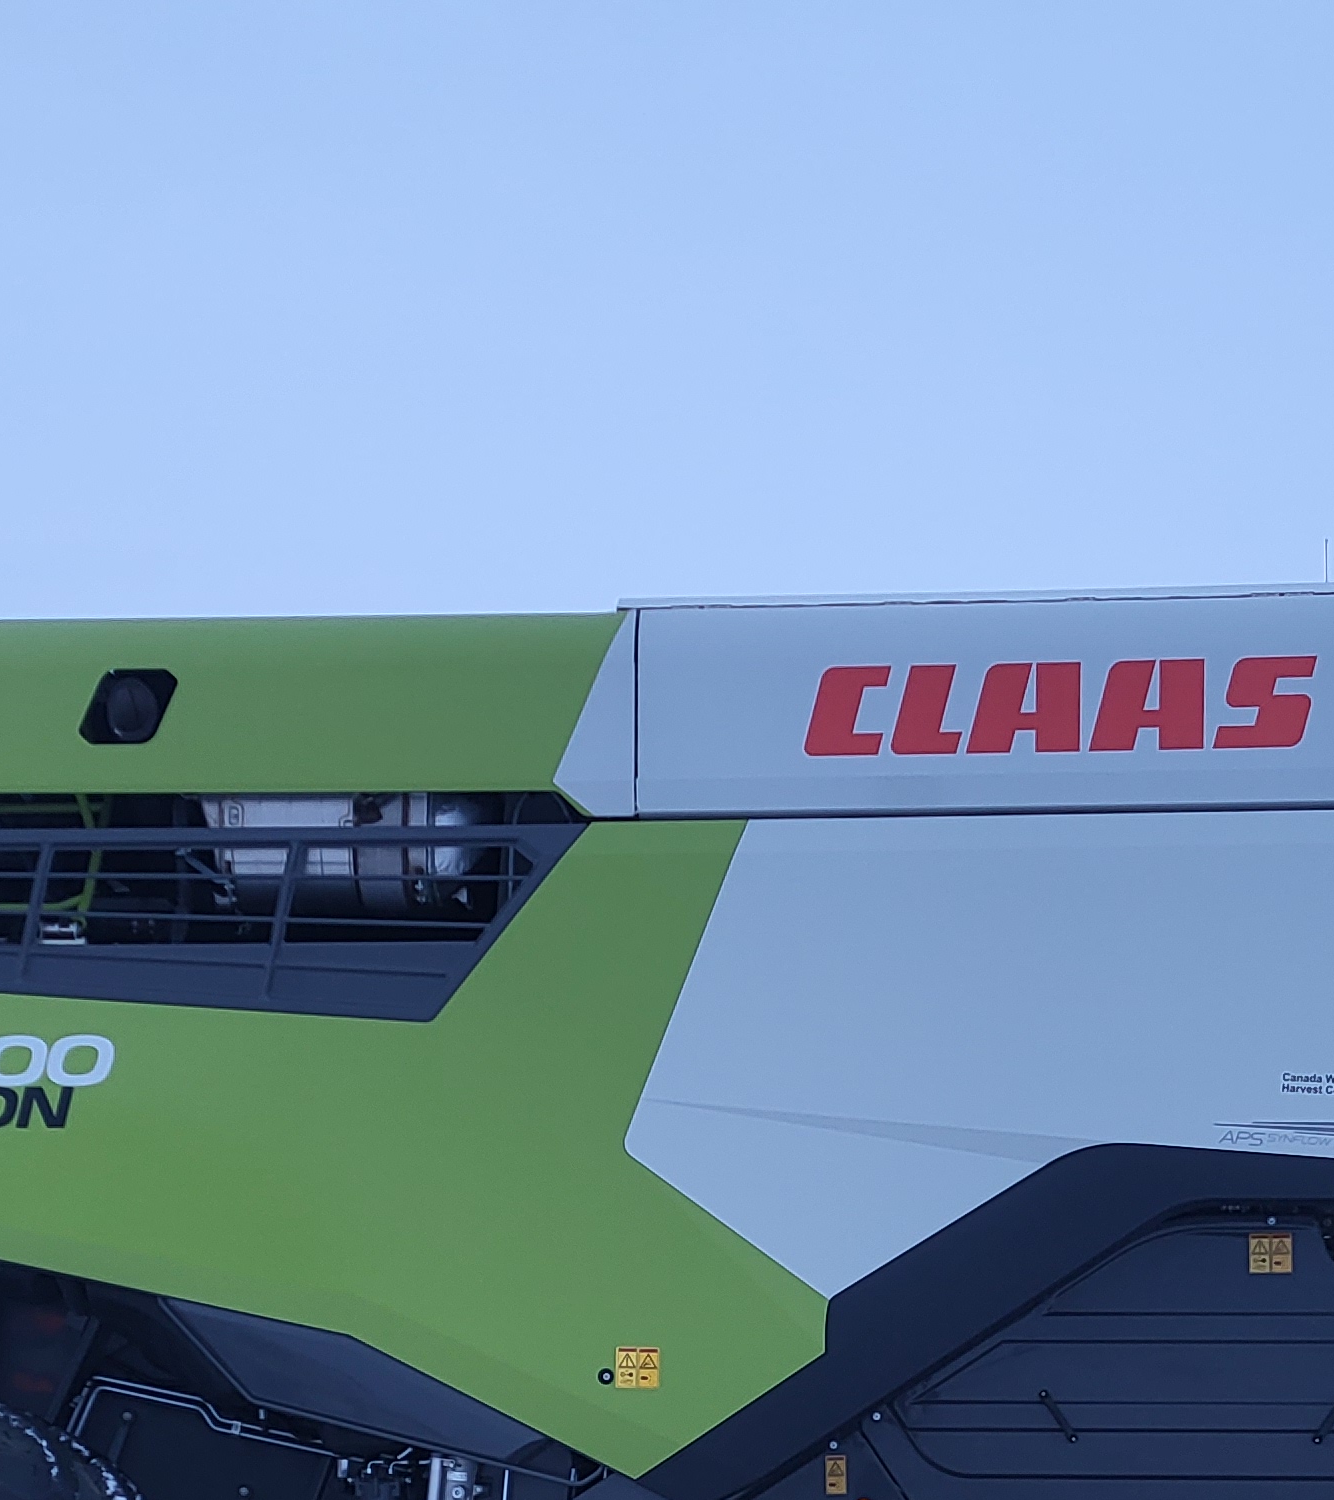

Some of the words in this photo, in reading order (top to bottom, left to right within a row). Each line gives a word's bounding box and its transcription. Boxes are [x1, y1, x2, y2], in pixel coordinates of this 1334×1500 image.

[804, 655, 1317, 757] CLAAS
[1282, 1072, 1323, 1083] Canada
[1281, 1084, 1323, 1095] Harvest
[1218, 1129, 1266, 1147] APS
[1267, 1133, 1332, 1146] SYNFLOW
